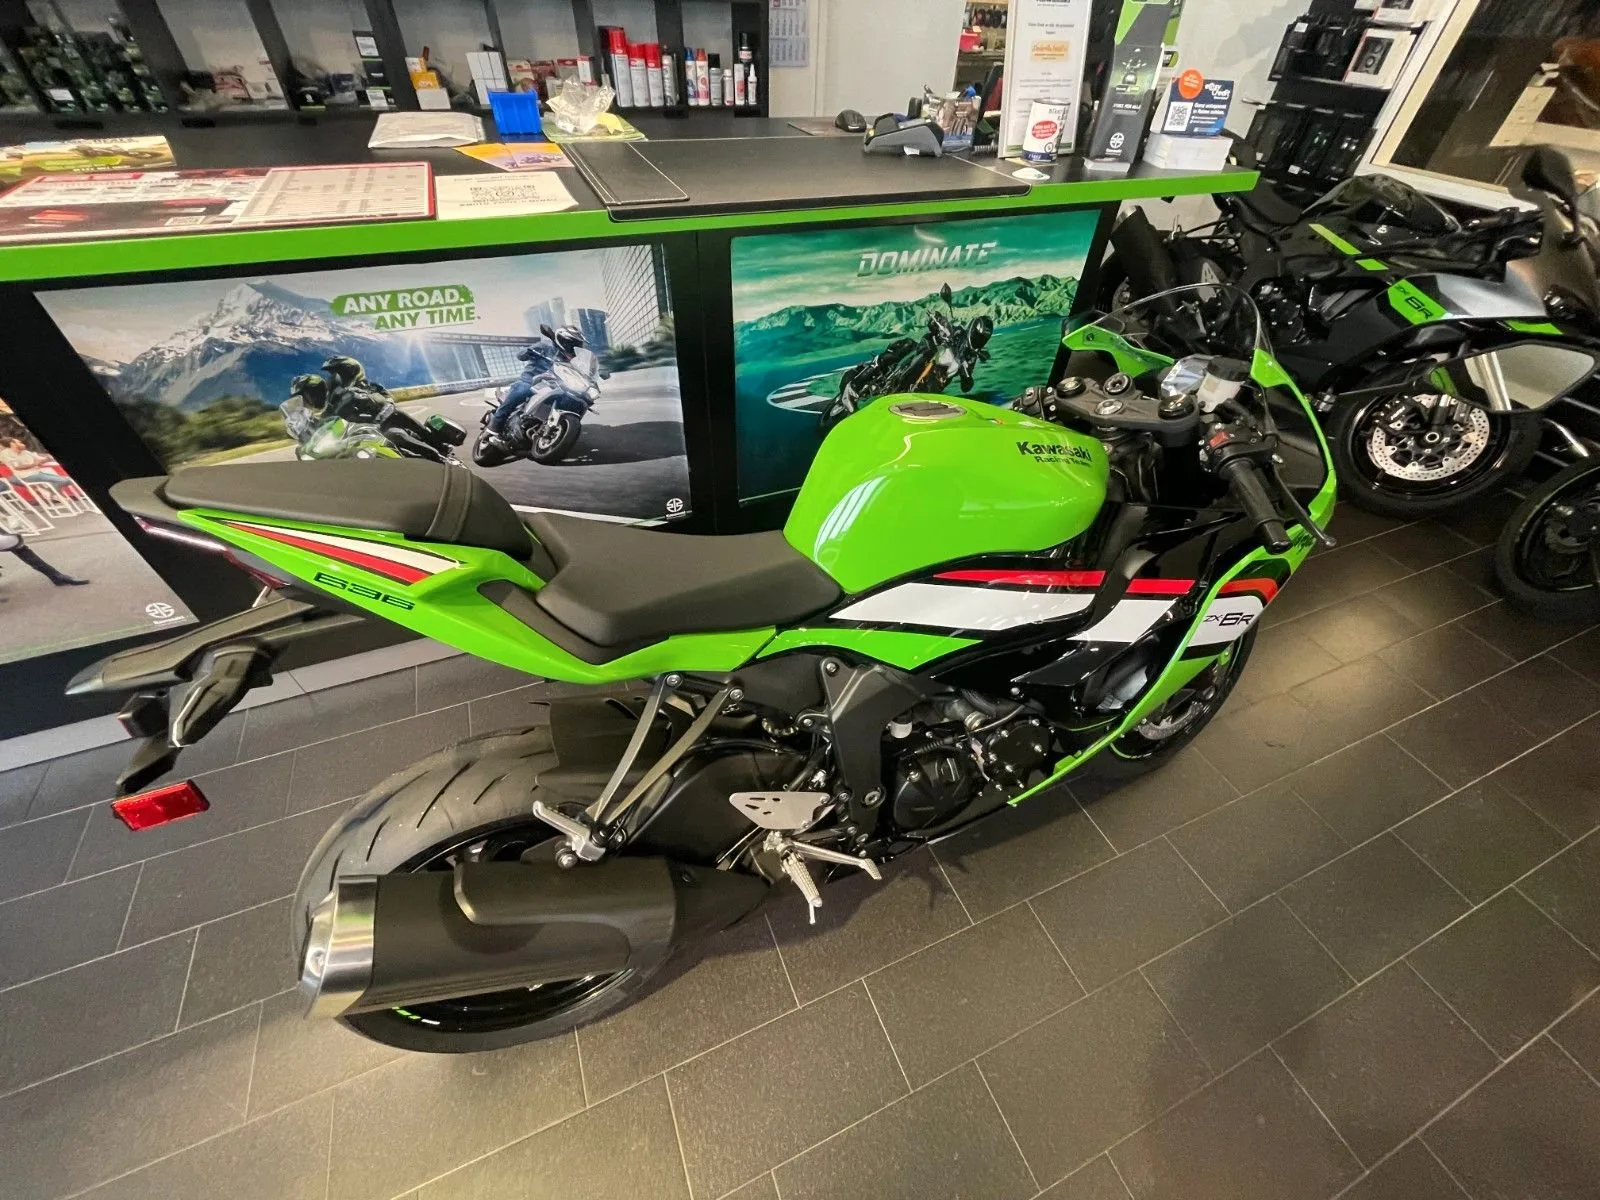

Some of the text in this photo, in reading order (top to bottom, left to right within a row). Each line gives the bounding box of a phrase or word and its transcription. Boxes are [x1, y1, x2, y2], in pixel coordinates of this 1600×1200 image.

[857, 241, 998, 277] DOMINATE
[343, 288, 465, 314] ANY ROAD.
[374, 306, 481, 331] ANY TIME.
[1016, 441, 1092, 463] Kawasaki
[313, 571, 416, 611] 636
